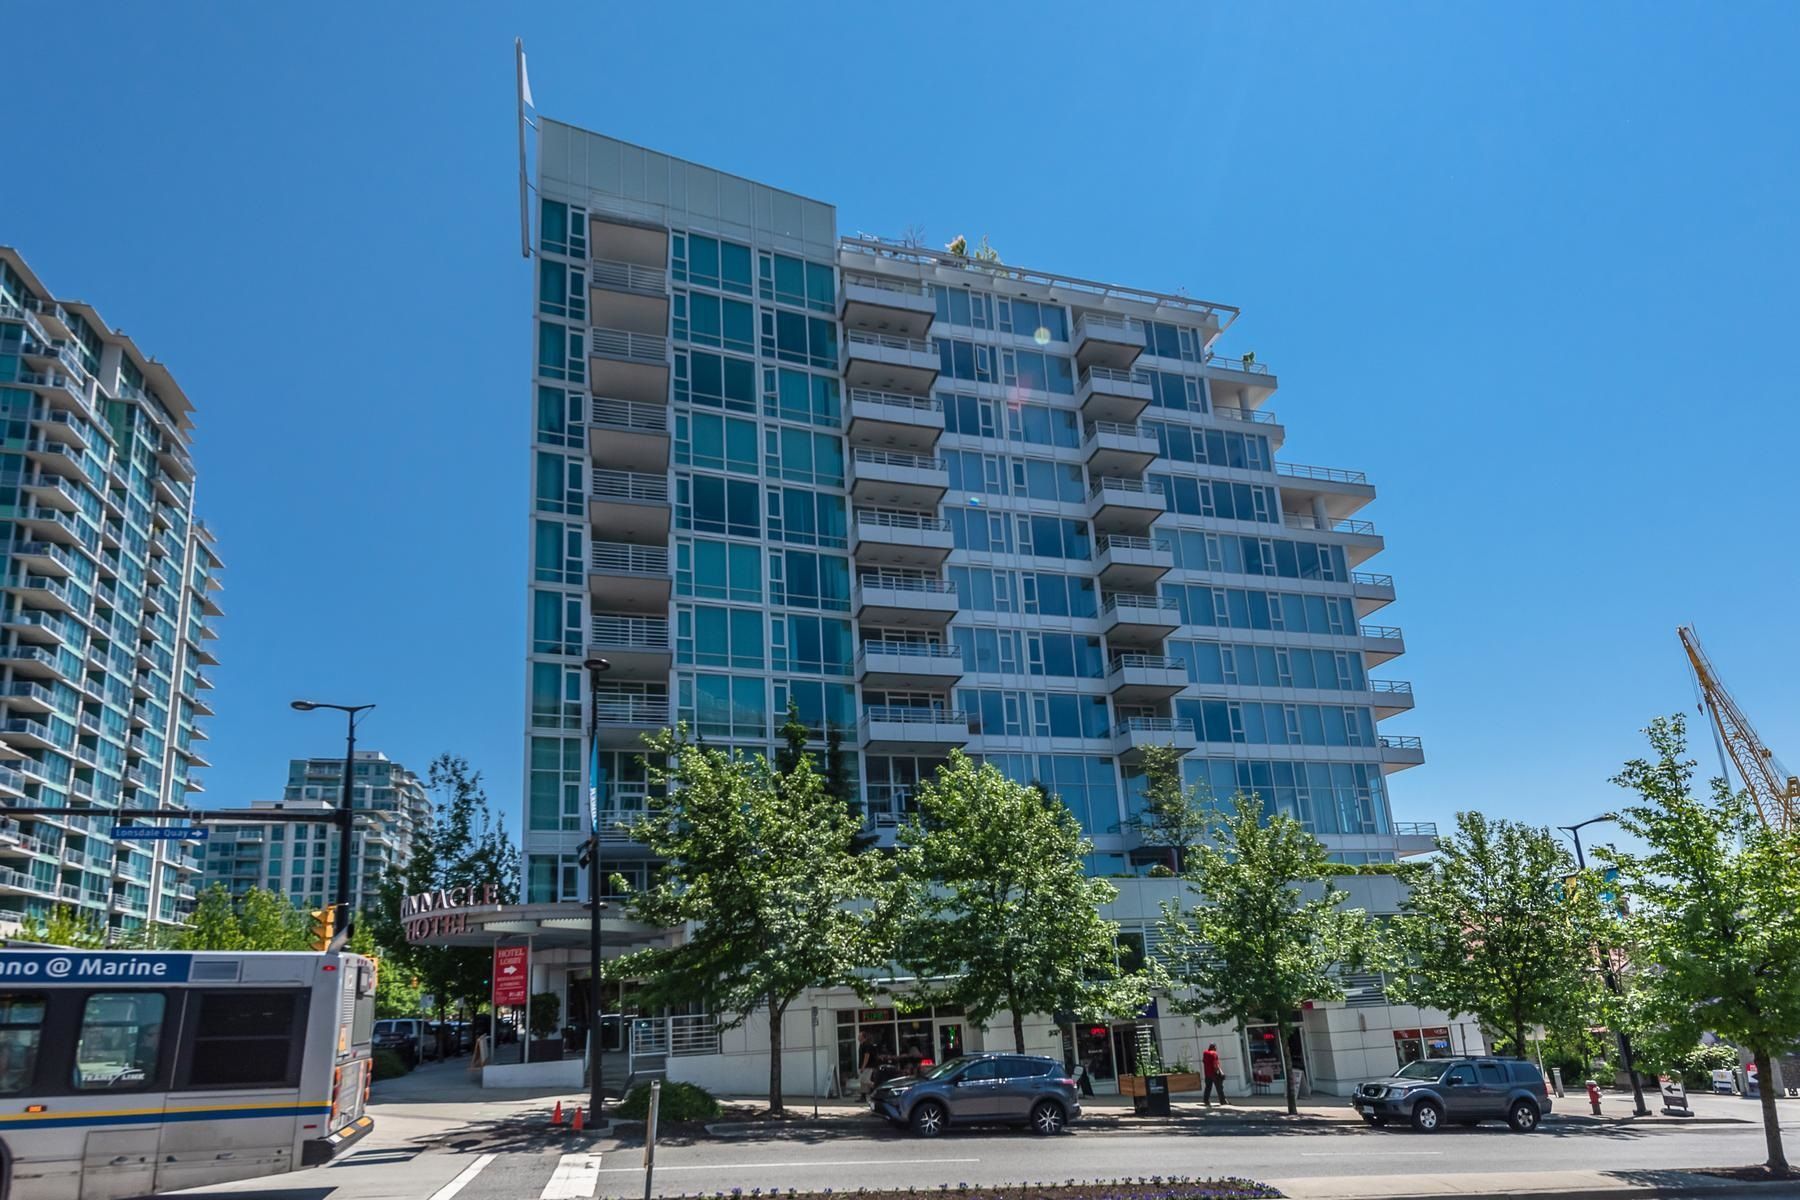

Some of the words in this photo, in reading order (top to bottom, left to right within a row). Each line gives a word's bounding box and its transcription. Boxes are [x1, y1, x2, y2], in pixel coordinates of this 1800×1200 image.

[115, 826, 160, 838] Lonsdale
[163, 826, 189, 840] Quay
[406, 913, 474, 941] HOTEL
[498, 948, 525, 958] HOTEL
[45, 957, 72, 977] @
[78, 957, 167, 975] Marine
